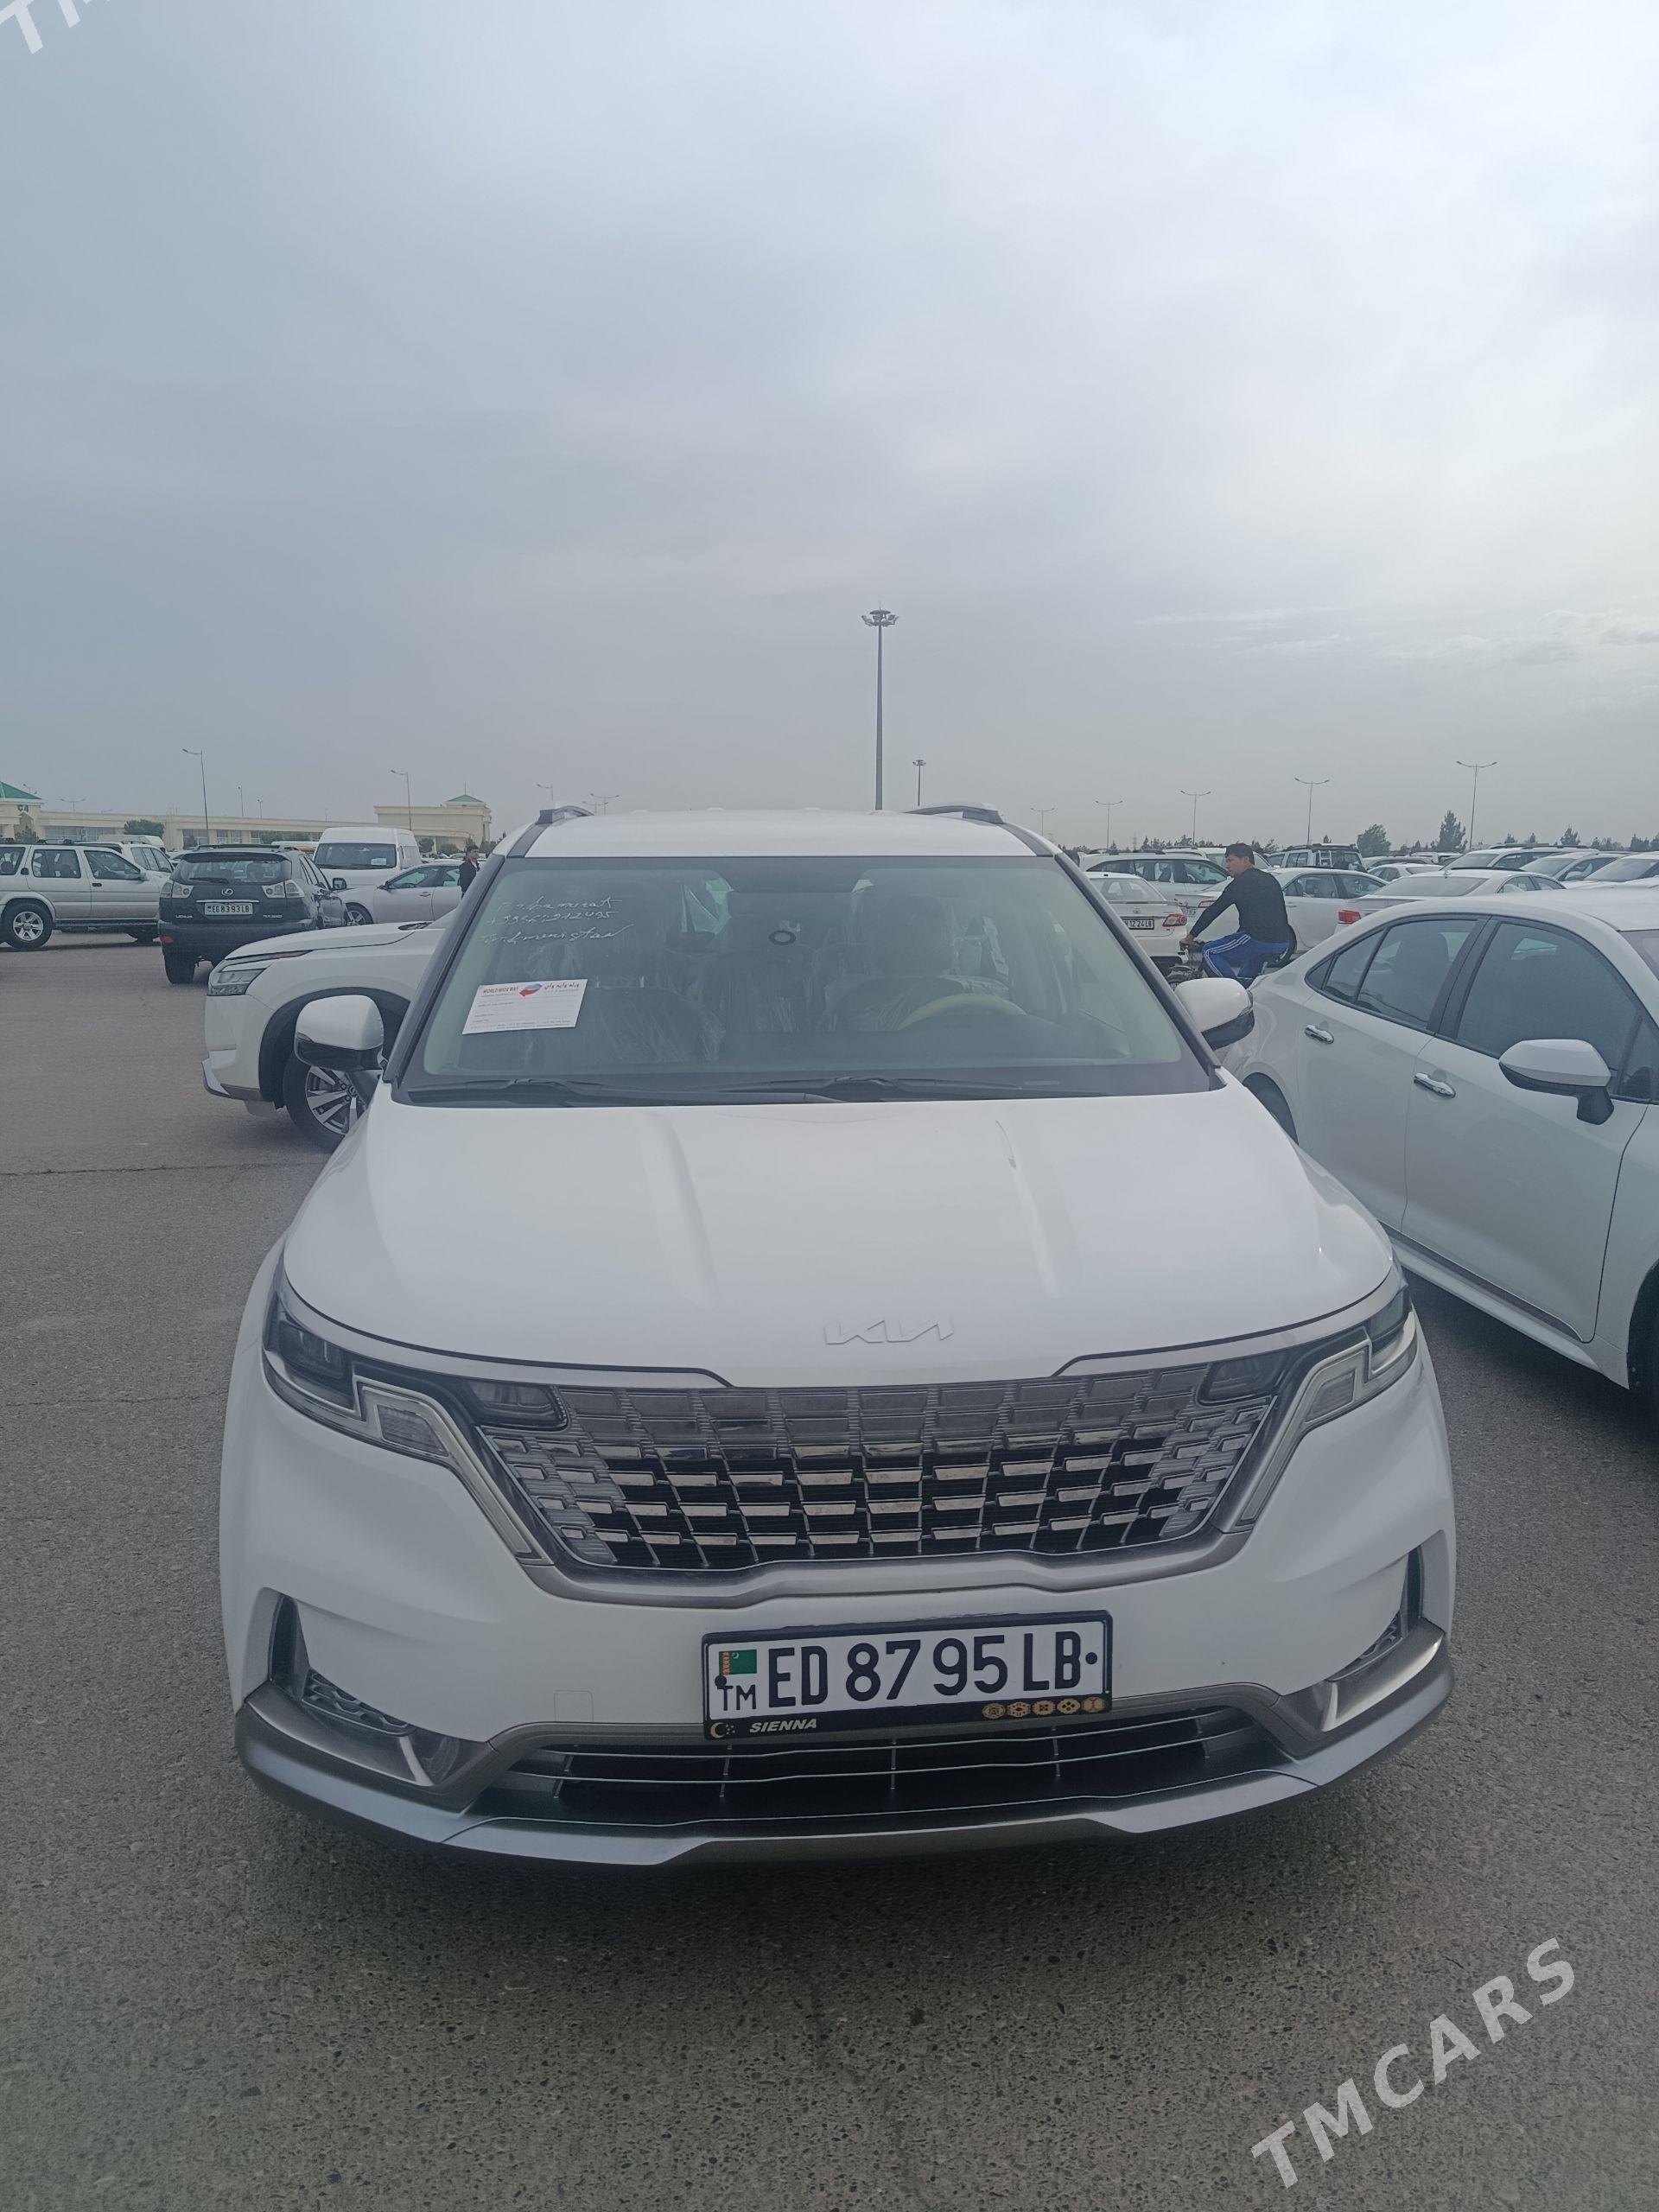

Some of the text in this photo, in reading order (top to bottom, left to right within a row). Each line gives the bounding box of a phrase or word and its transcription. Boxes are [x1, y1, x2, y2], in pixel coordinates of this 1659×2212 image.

[767, 1645, 829, 1708] ED
[1023, 1630, 1081, 1692] LB
[749, 1718, 817, 1734] SIENNA
